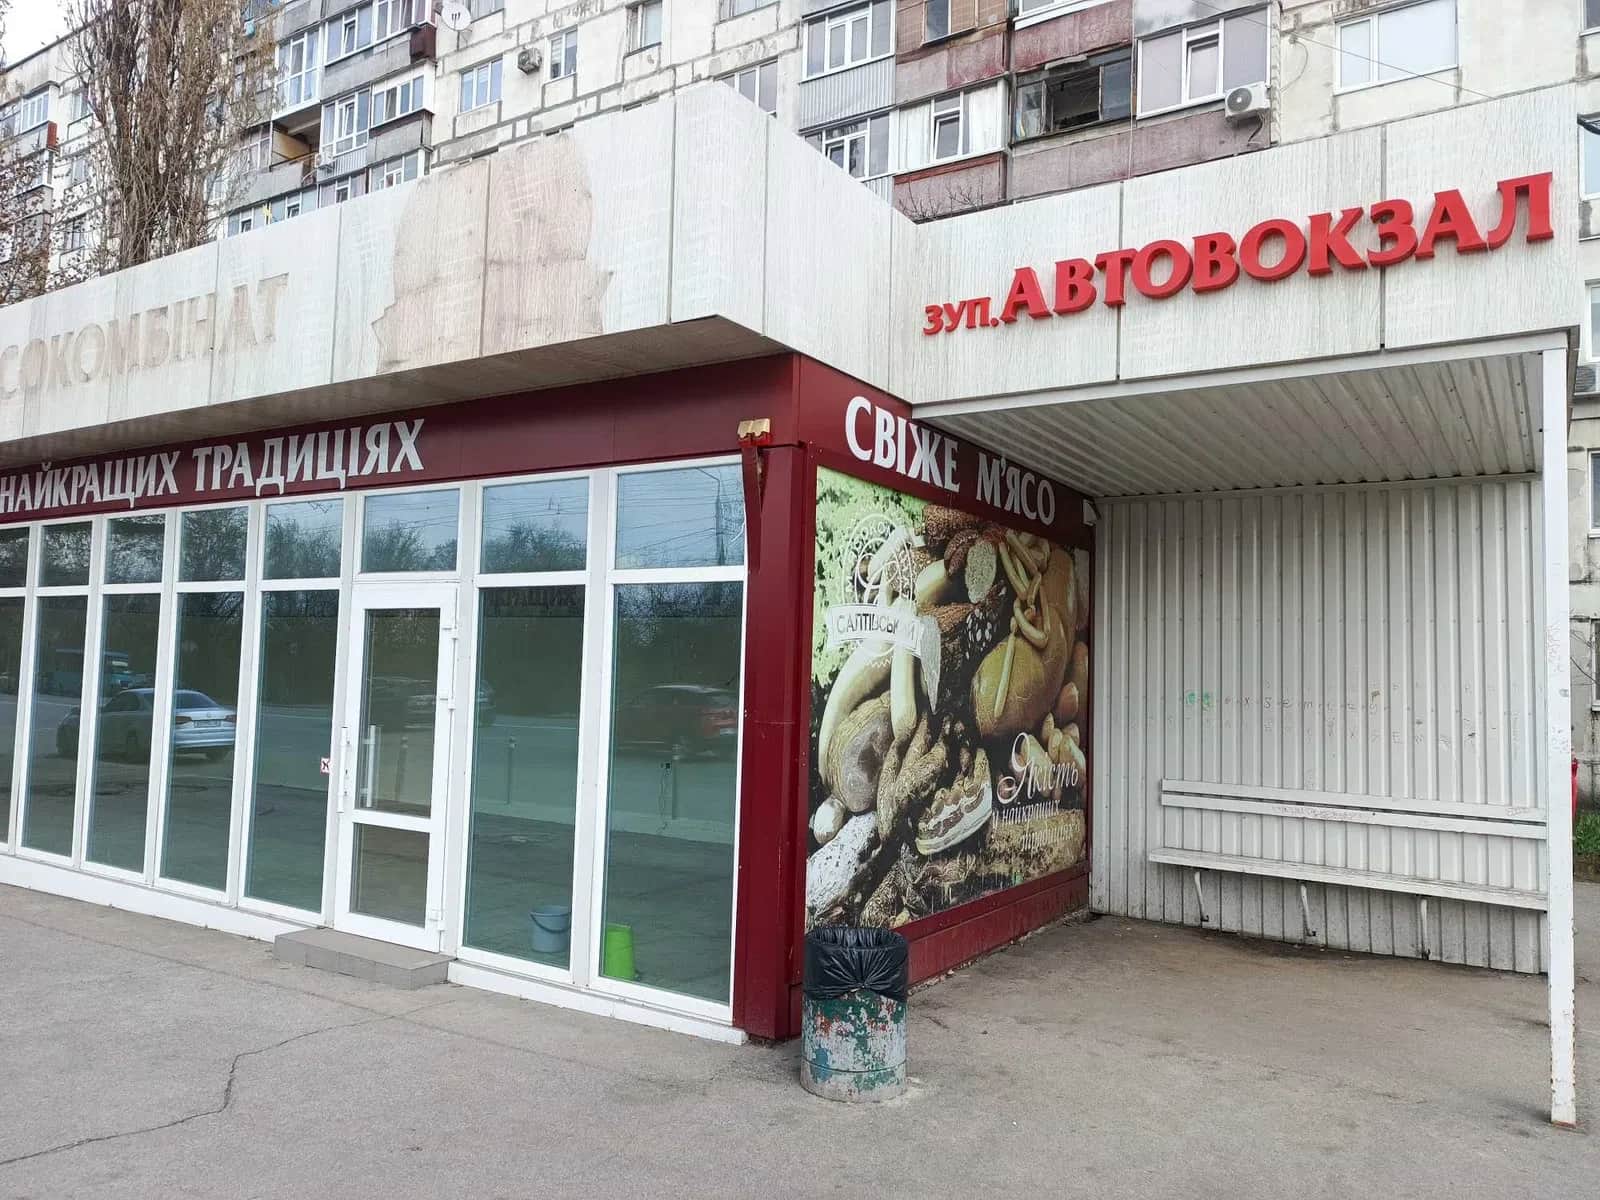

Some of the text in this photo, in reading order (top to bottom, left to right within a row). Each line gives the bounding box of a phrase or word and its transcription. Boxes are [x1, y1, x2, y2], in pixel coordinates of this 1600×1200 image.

[1000, 172, 1554, 322] АВТОВОКЗАЛ
[0, 418, 425, 514] НАЙКРАЩИХ ТРАДИЦІЯХ
[845, 396, 960, 493] СВІЖЕ
[997, 732, 1079, 804] Якість
